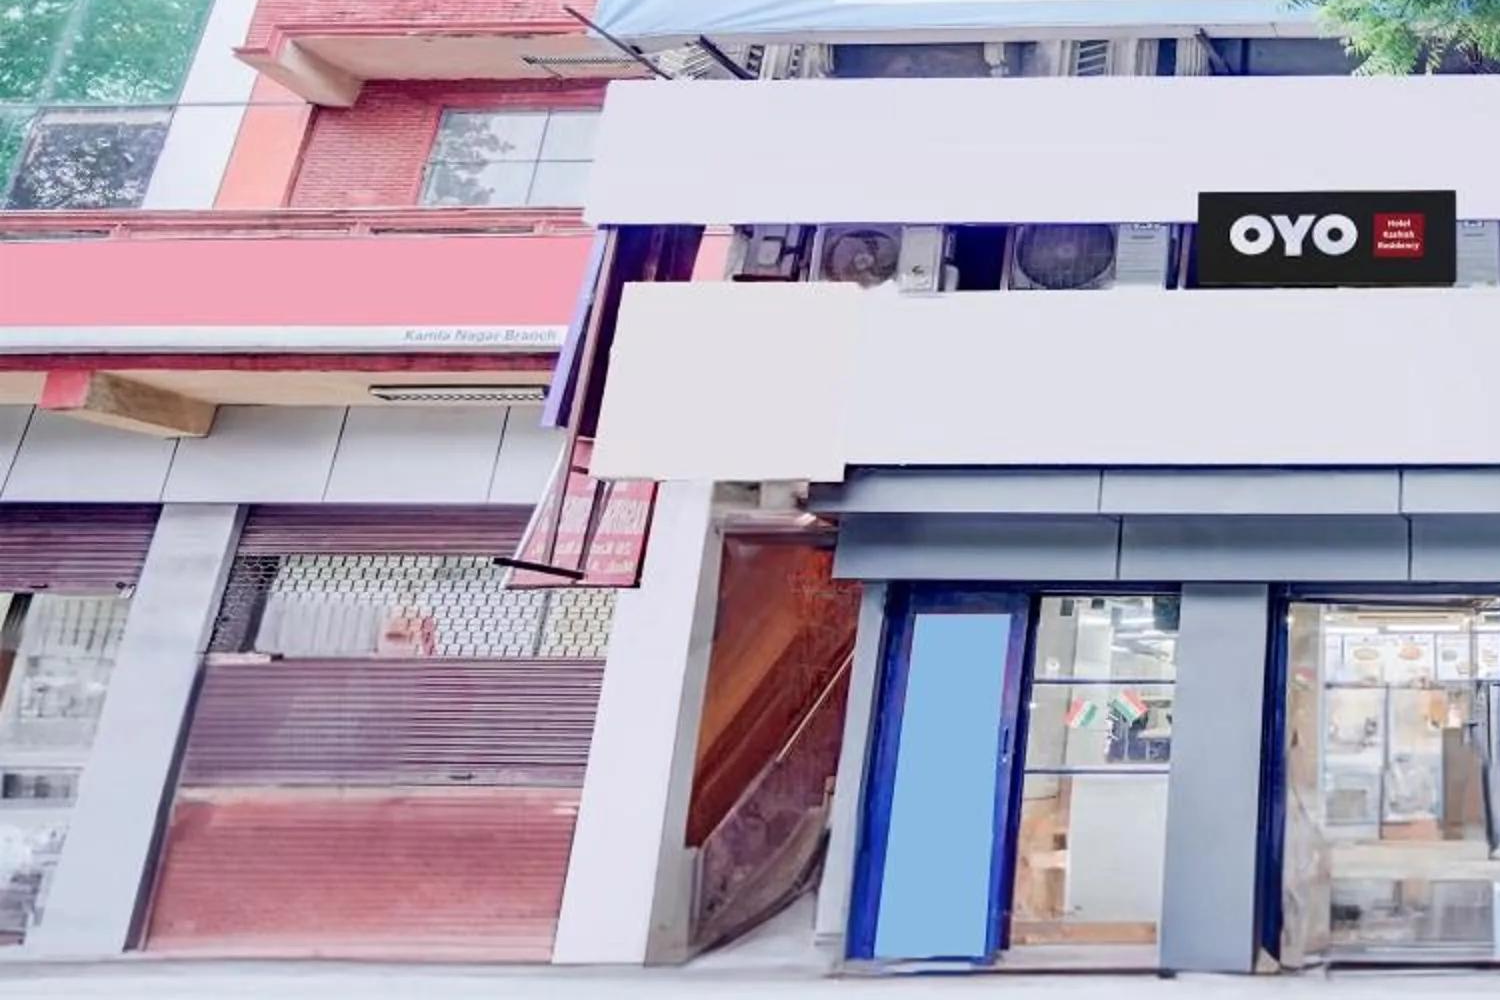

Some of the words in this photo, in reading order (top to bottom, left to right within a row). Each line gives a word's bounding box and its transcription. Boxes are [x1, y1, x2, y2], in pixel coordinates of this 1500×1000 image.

[1387, 218, 1411, 228] Hotel
[1229, 213, 1359, 257] OYO
[1377, 241, 1421, 251] Residency
[403, 329, 451, 341] Kamla
[454, 330, 501, 343] Nagar
[503, 330, 558, 342] Branch
